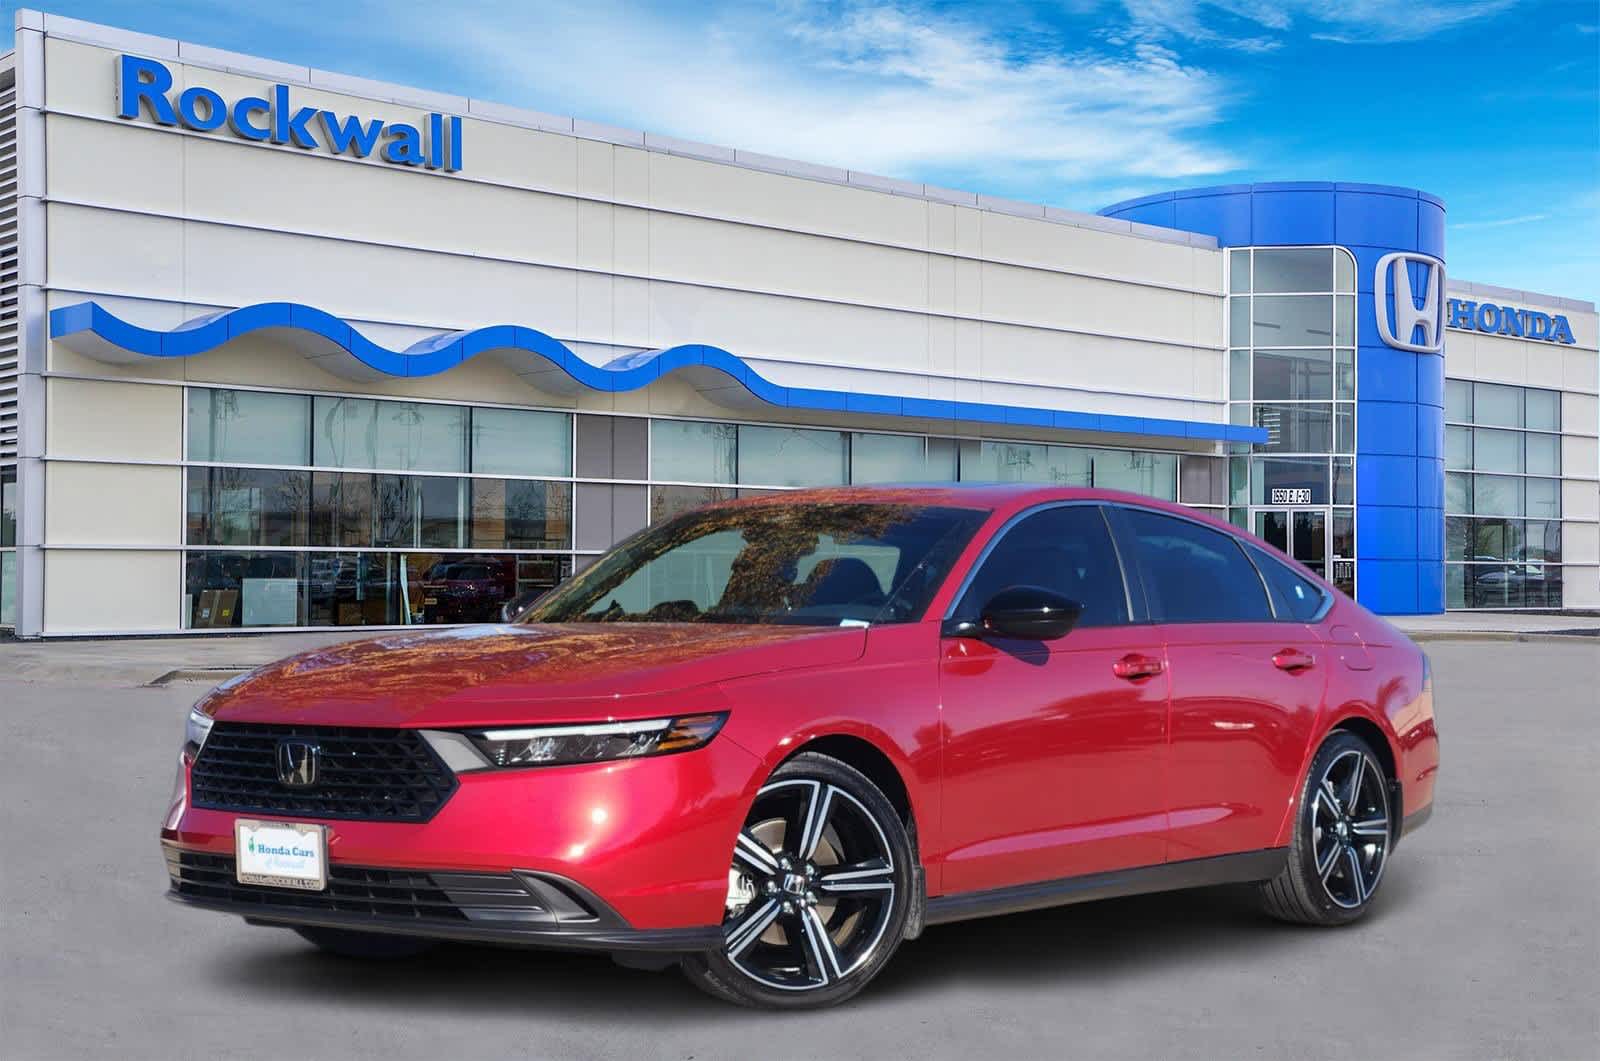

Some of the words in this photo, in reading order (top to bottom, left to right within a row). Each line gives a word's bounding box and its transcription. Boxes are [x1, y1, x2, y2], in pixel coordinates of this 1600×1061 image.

[116, 53, 464, 173] Rockwall
[1447, 298, 1577, 345] HONDA
[258, 844, 291, 856] Honda
[292, 846, 315, 857] Cars
